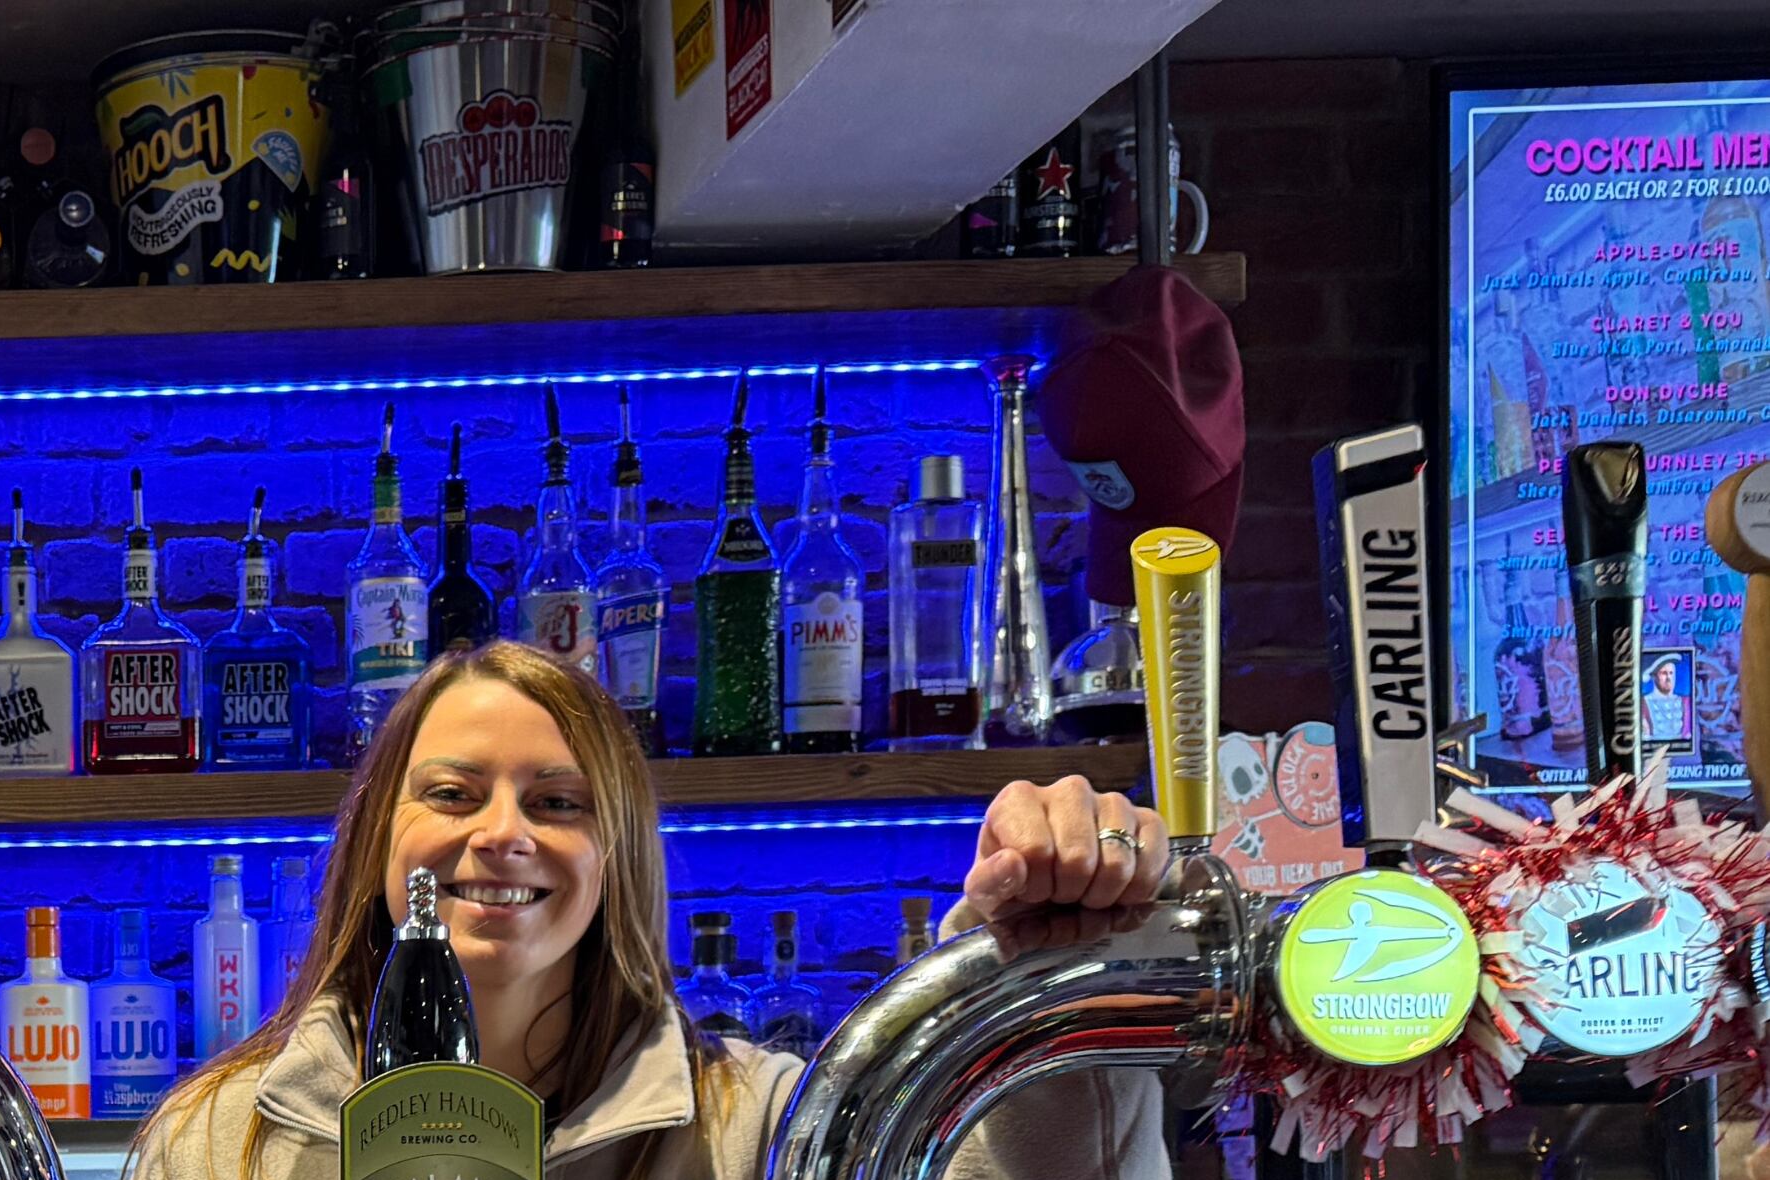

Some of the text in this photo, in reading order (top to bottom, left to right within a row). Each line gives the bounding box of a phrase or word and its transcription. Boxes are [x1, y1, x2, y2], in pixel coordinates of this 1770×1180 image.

[119, 104, 219, 199] HOOCH
[1526, 137, 1703, 176] COCKTAIL
[428, 131, 570, 203] DESPERADOS
[1545, 182, 1590, 202] £6.00
[1594, 180, 1639, 200] EACH
[1643, 180, 1666, 198] OR
[1671, 180, 1682, 197] 2
[1685, 178, 1719, 197] FOR
[131, 200, 216, 248] REFRESHING
[1481, 274, 1520, 292] Jack
[1527, 270, 1593, 289] Daniels
[1591, 315, 1671, 334] CLARET
[1702, 312, 1743, 329] YOU
[1552, 341, 1589, 358] Blue
[1605, 383, 1728, 402] DON DYCHE
[1532, 409, 1571, 430] Jack
[1646, 455, 1728, 471] URNLEY
[1670, 548, 1722, 566] Orang
[1671, 594, 1742, 611] VENOM
[791, 615, 858, 645] PIMM'S
[1362, 528, 1427, 741] CARLING
[1680, 615, 1743, 634] Comfor
[108, 653, 176, 685] AFTER
[223, 662, 290, 695] AFTER
[1169, 589, 1209, 782] STRONGBOW
[1610, 626, 1637, 755] GUINNESS
[110, 686, 177, 716] SHOCK
[224, 695, 290, 724] SHOCK
[219, 954, 240, 1022] WKD
[1564, 951, 1700, 999] ARLING
[1312, 992, 1451, 1021] STRONGBOW
[8, 1024, 80, 1062] LUJO
[95, 1020, 169, 1060] LUJO
[1330, 1024, 1430, 1036] ORIGINAL CIDER
[360, 1091, 520, 1151] REEDLEY HALLOWS
[401, 1135, 454, 1144] BREWING
